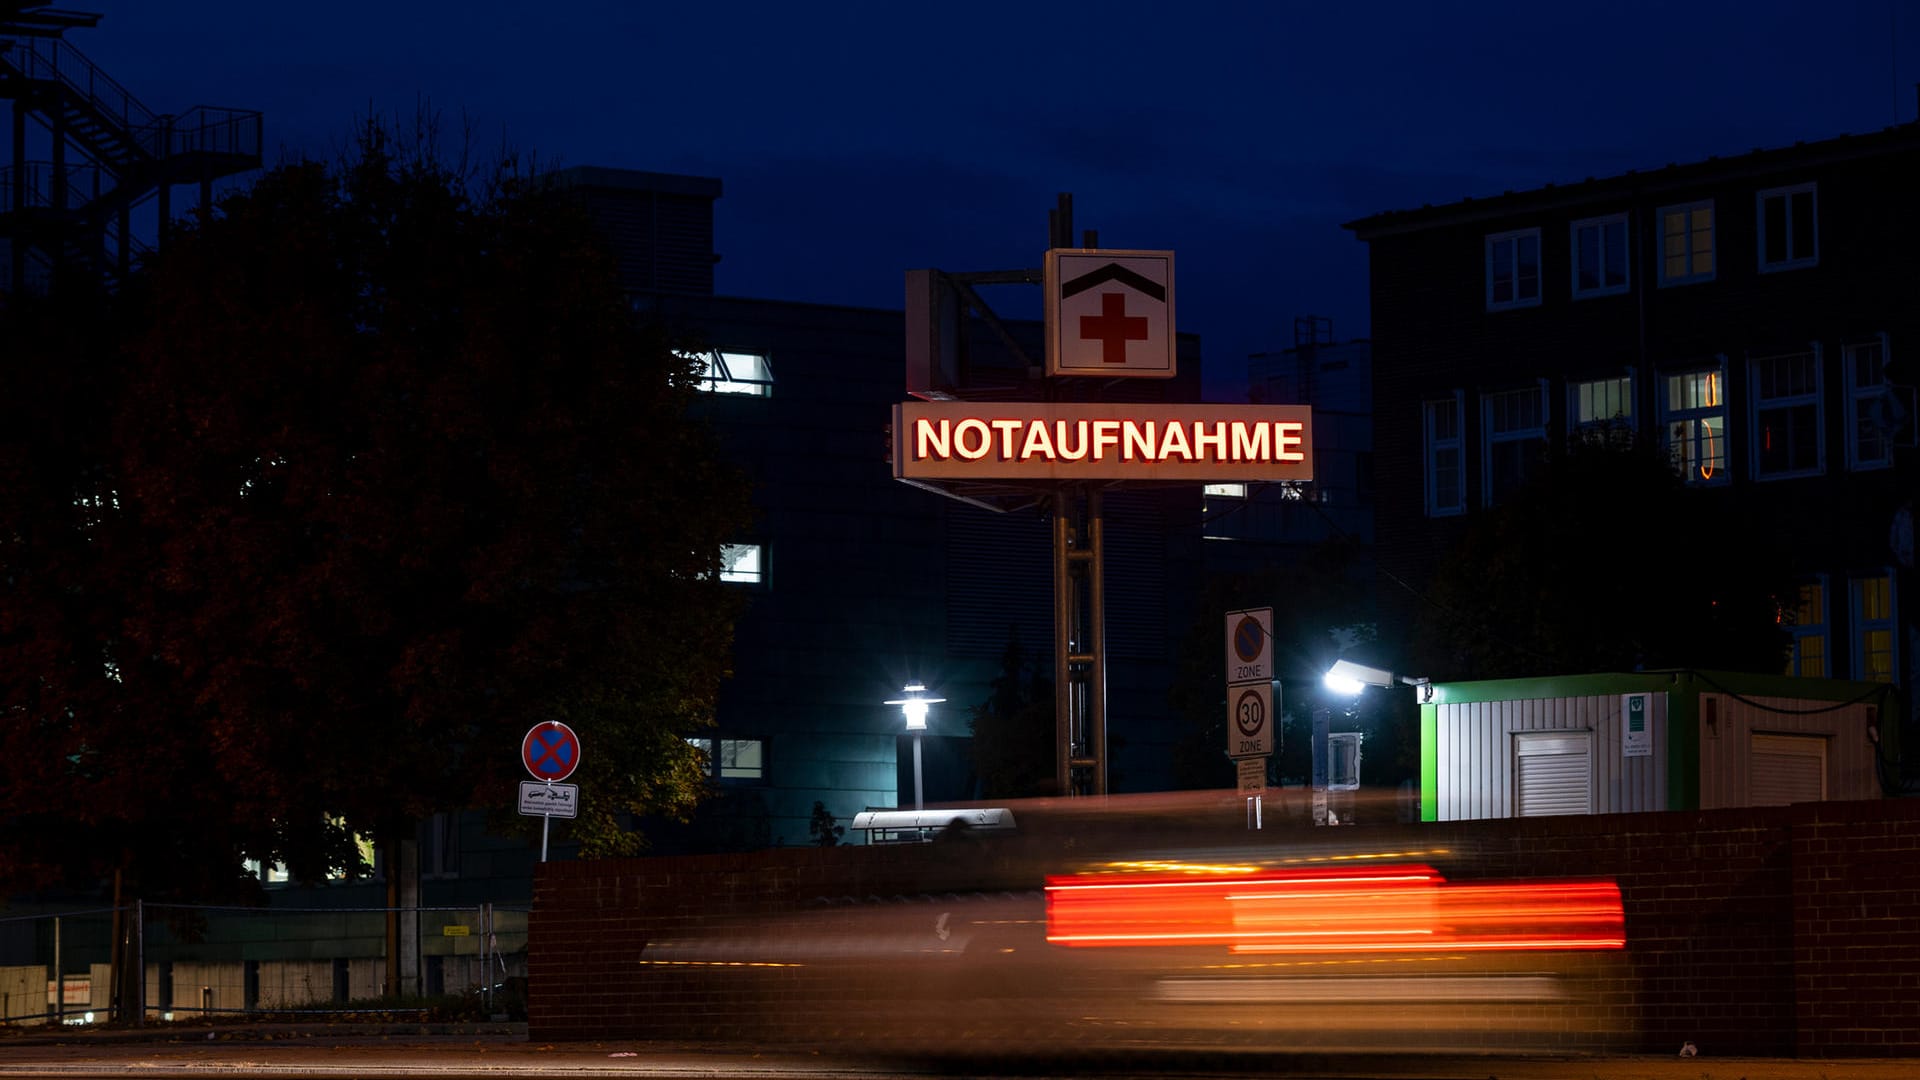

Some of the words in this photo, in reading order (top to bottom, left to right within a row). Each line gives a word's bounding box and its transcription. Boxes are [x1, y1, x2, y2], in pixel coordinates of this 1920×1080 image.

[916, 418, 1305, 462] NOTAUFNAHME
[1238, 664, 1262, 679] ZONE
[1241, 702, 1260, 725] 30
[1239, 740, 1262, 753] ZONE
